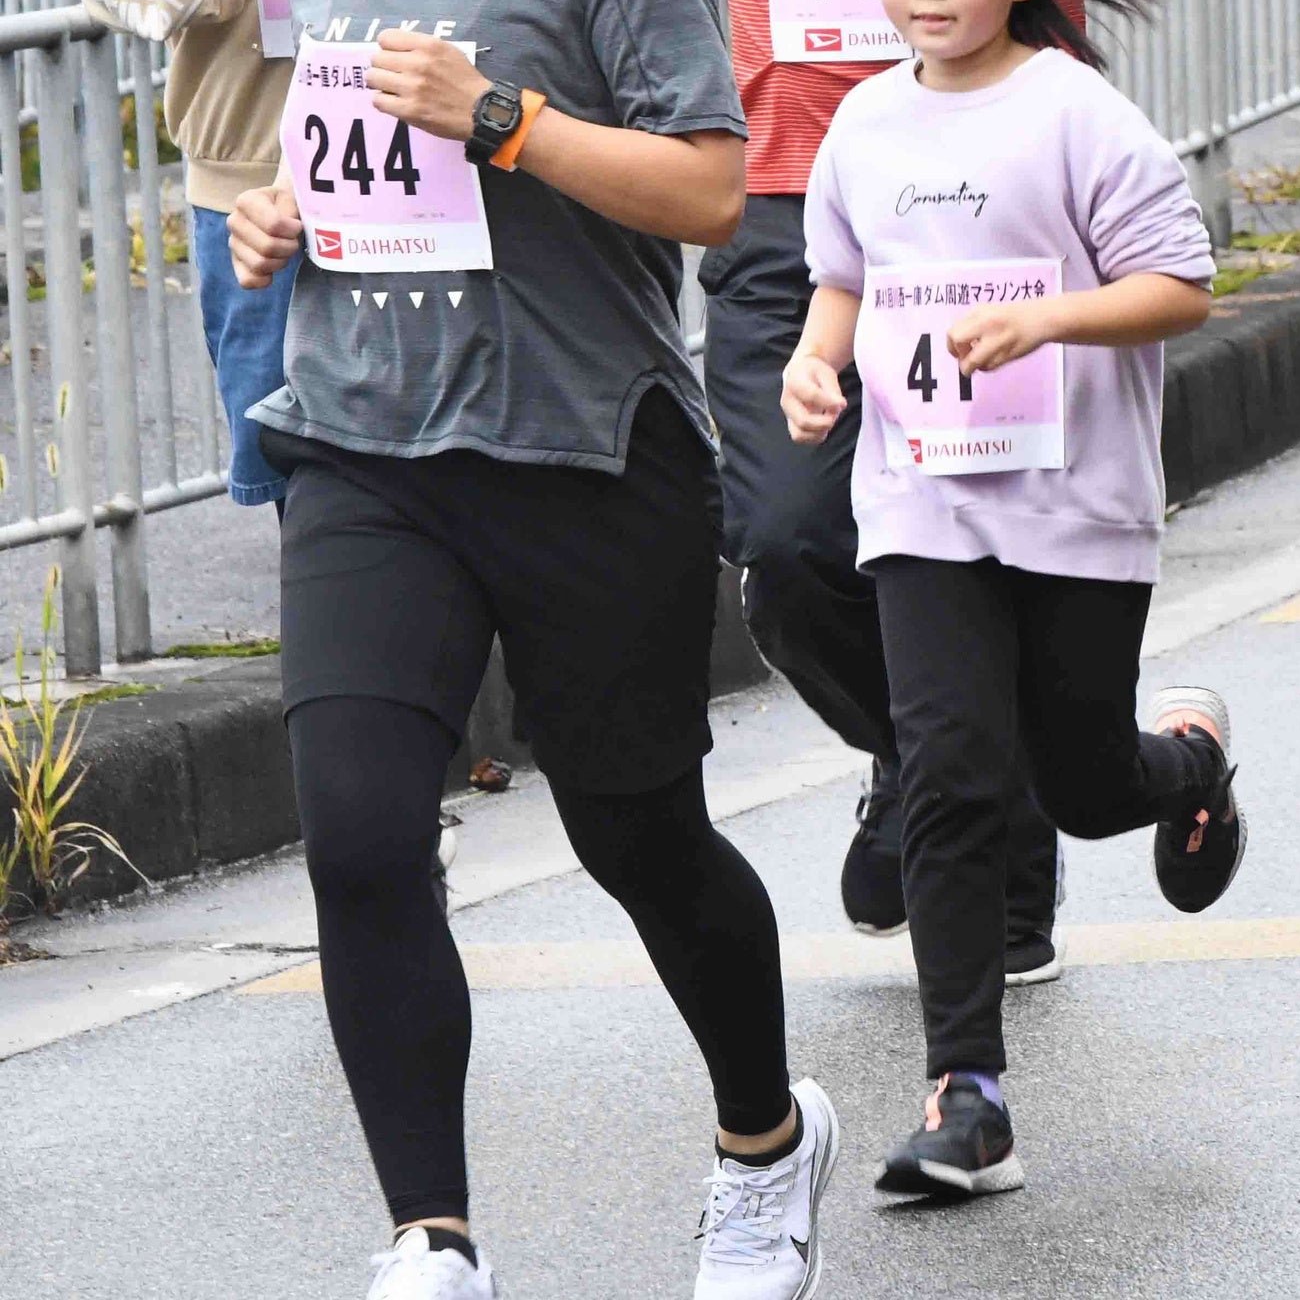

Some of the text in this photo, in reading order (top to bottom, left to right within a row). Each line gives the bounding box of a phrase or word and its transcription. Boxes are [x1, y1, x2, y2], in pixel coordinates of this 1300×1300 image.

[848, 31, 907, 46] DAIHA
[304, 113, 422, 196] 244
[348, 237, 437, 255] DAIHATSU
